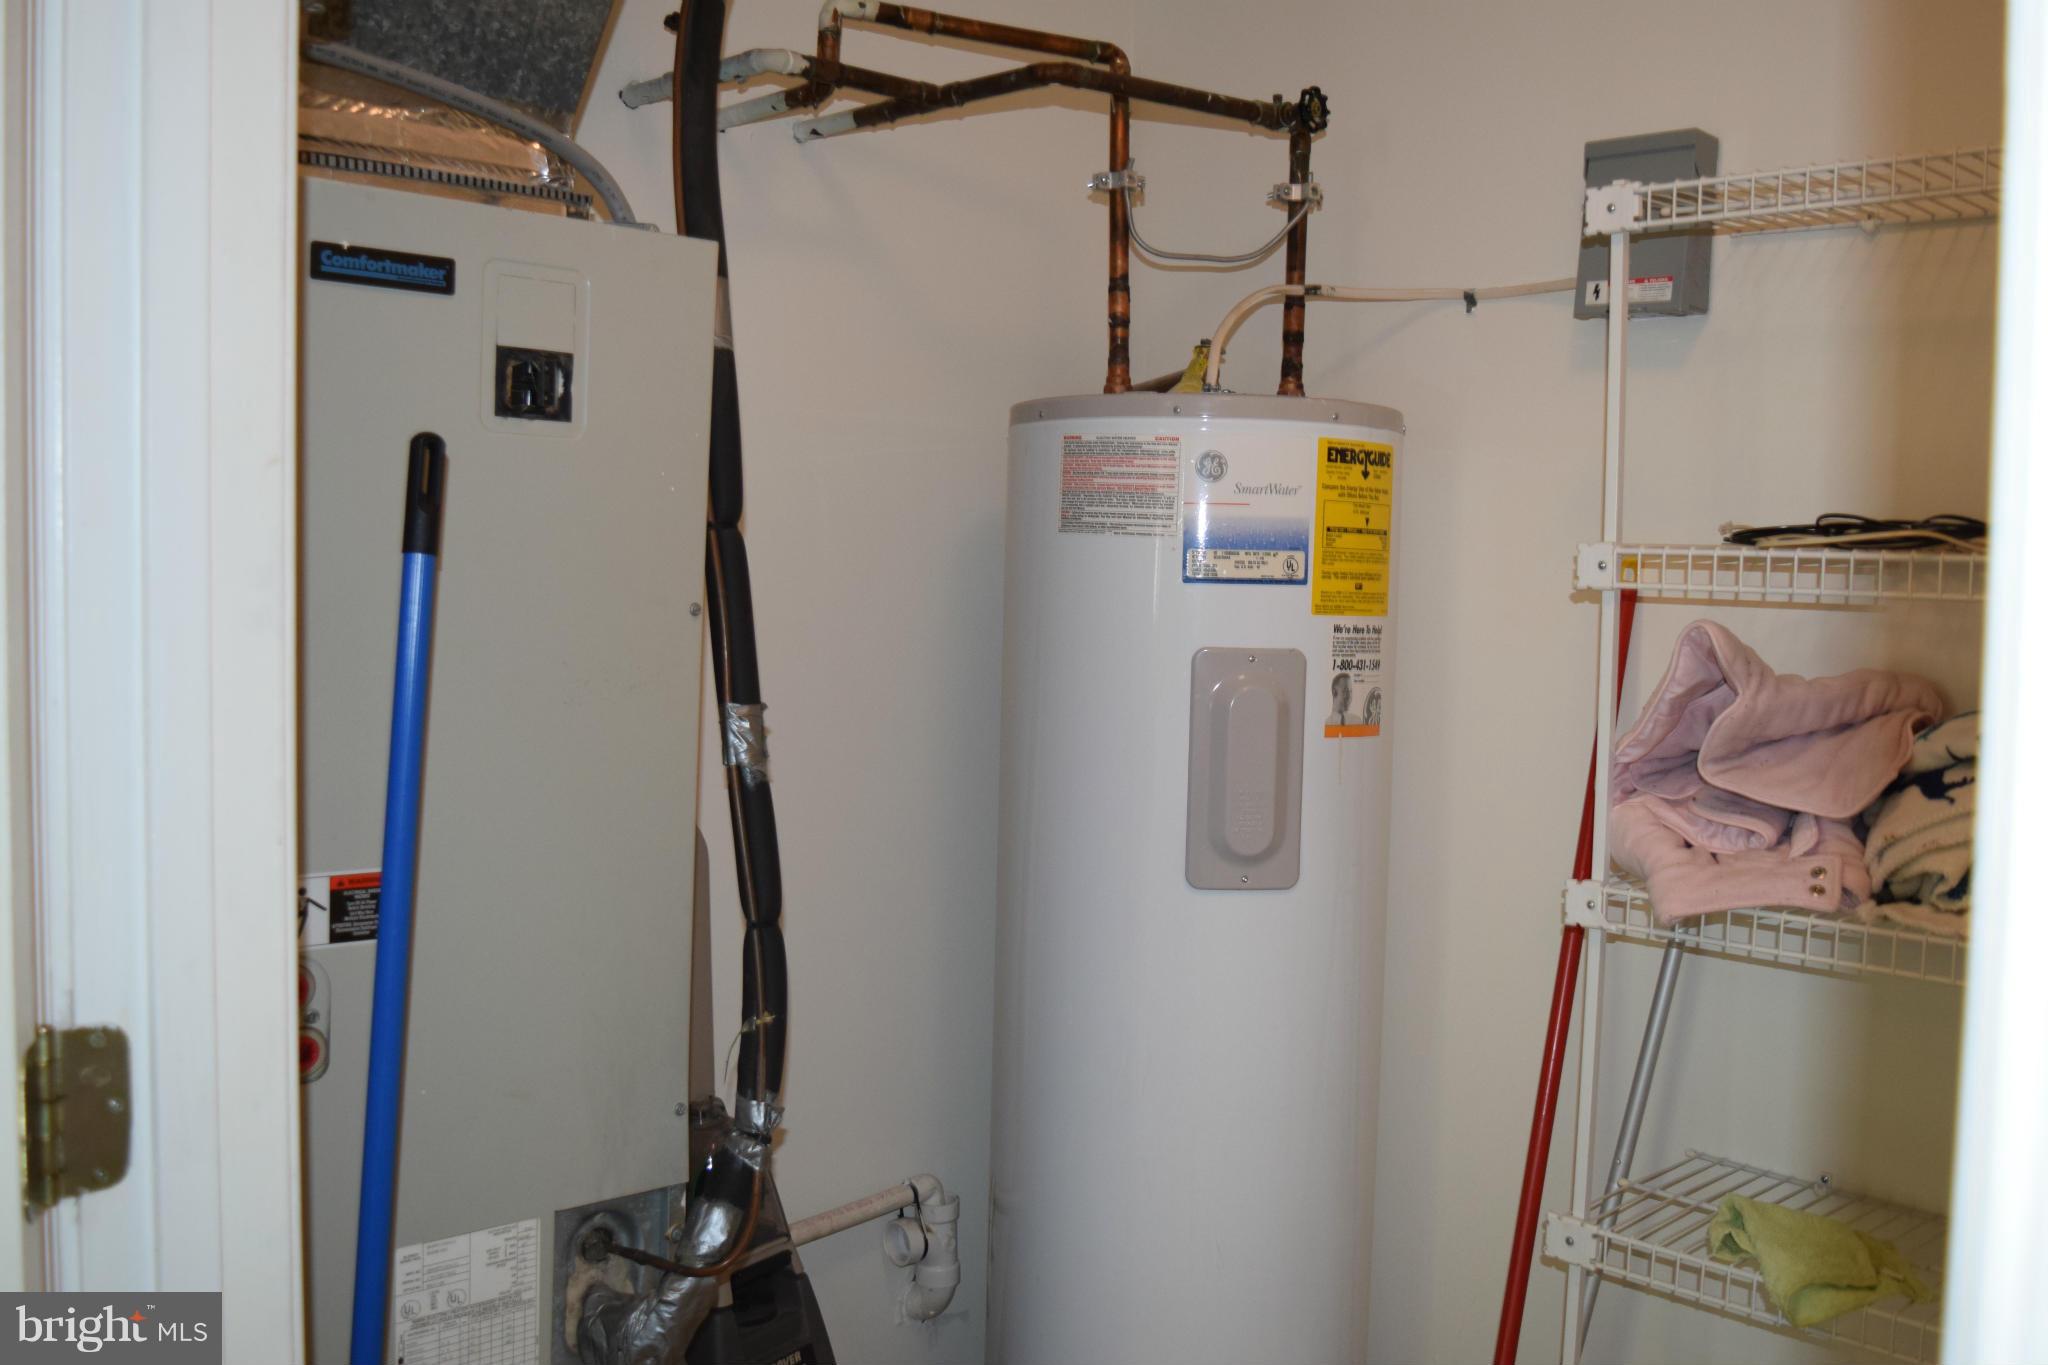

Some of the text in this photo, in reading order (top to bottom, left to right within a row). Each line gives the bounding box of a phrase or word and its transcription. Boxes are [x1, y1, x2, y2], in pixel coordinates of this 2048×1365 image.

[320, 250, 447, 280] Comfortmaker
[1233, 482, 1297, 496] SmartWater
[1333, 624, 1351, 634] We're
